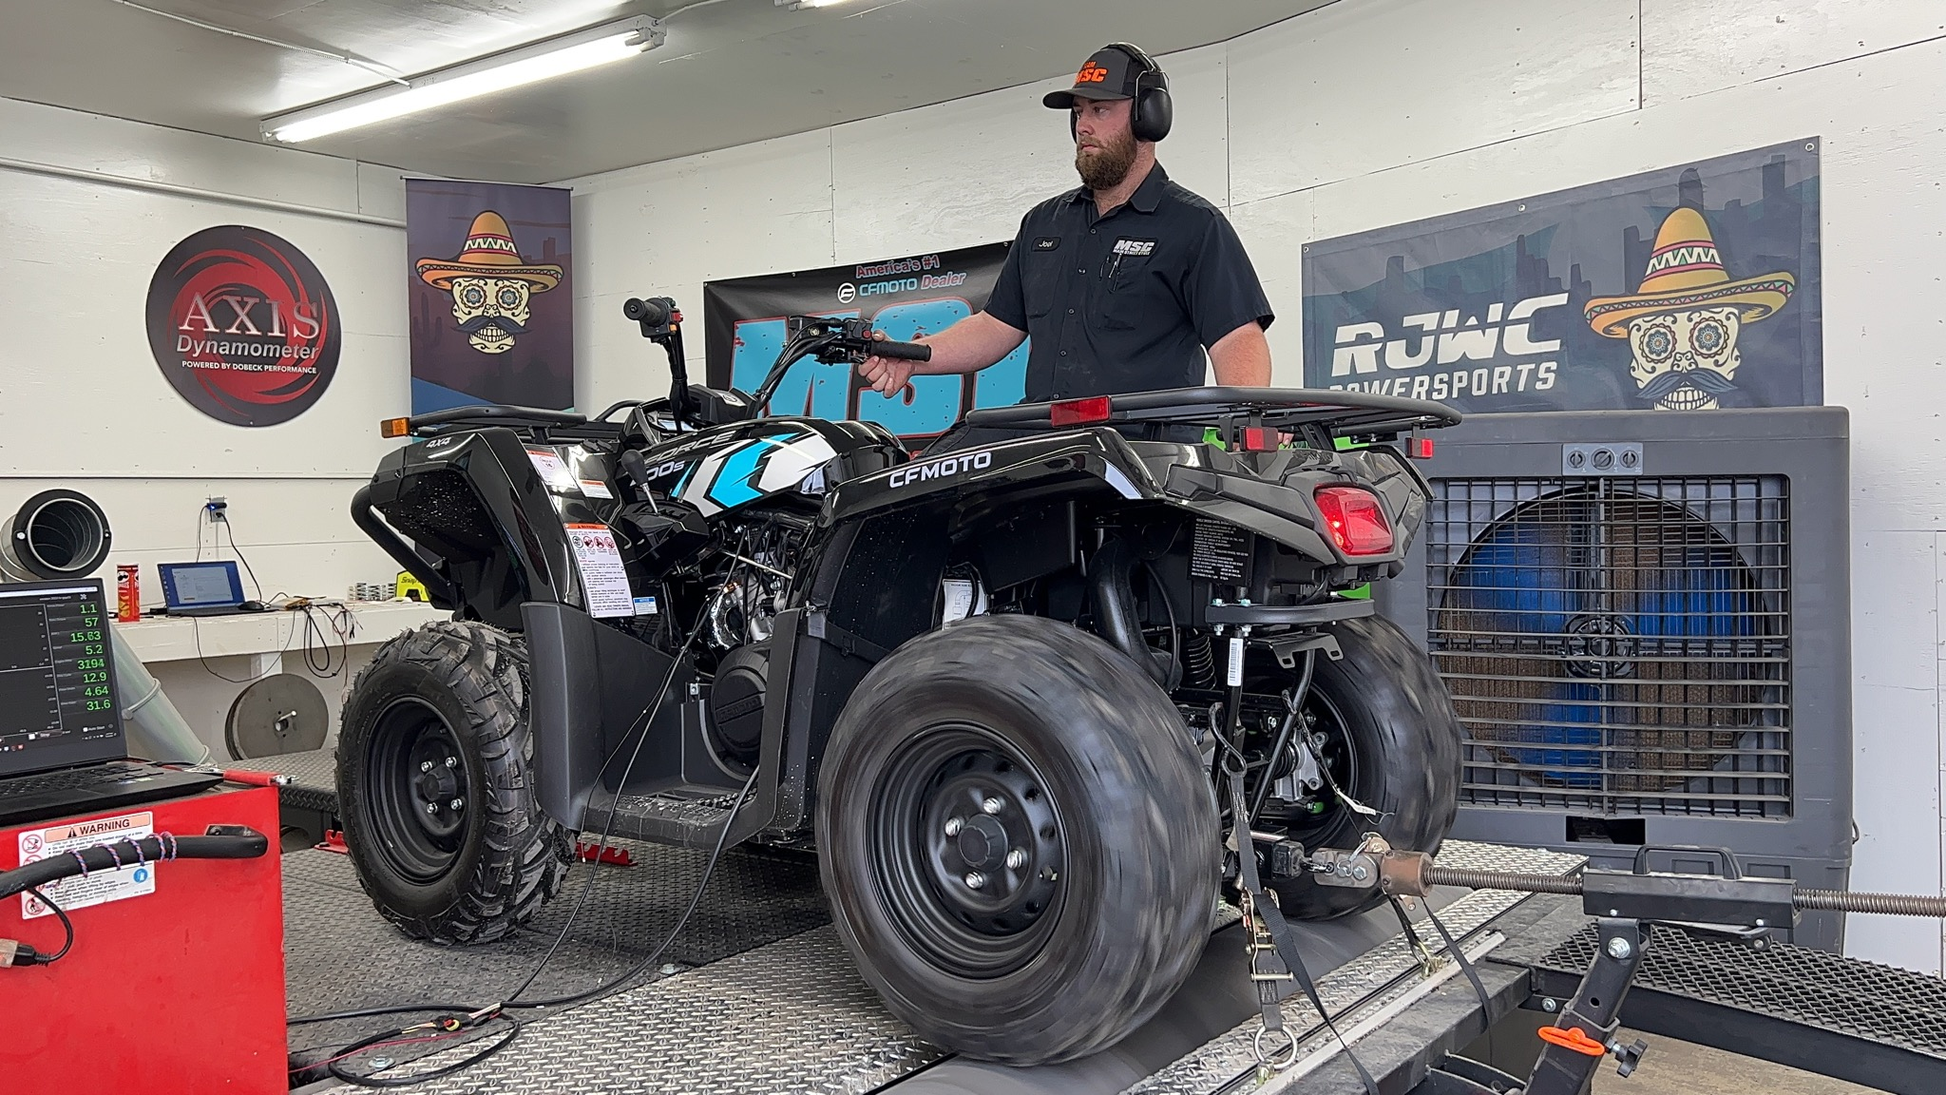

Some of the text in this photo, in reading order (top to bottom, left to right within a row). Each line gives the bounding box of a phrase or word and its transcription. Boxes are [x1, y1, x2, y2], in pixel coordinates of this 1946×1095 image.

[1113, 239, 1155, 252] MSC
[855, 254, 940, 279] America's #1
[859, 271, 967, 297] CFMOTO Dealer
[178, 291, 320, 340] AXIS
[1330, 292, 1569, 377] RJWC
[176, 333, 320, 360] Dynamometer
[181, 360, 317, 374] POWERED BY DOBECK PERFORMANCE
[1329, 361, 1558, 400] WERSPORTS
[644, 430, 737, 465] FORCE
[889, 451, 992, 489] CFMOTO
[79, 603, 97, 614] 1.1
[85, 617, 99, 627] 57
[70, 631, 101, 643] 15.63
[85, 644, 103, 655] 5.2
[77, 658, 105, 670] 3194
[83, 671, 107, 683] 12.9
[84, 685, 109, 697] 4.64
[86, 699, 111, 711] 31.6
[79, 818, 130, 835] WARNING
